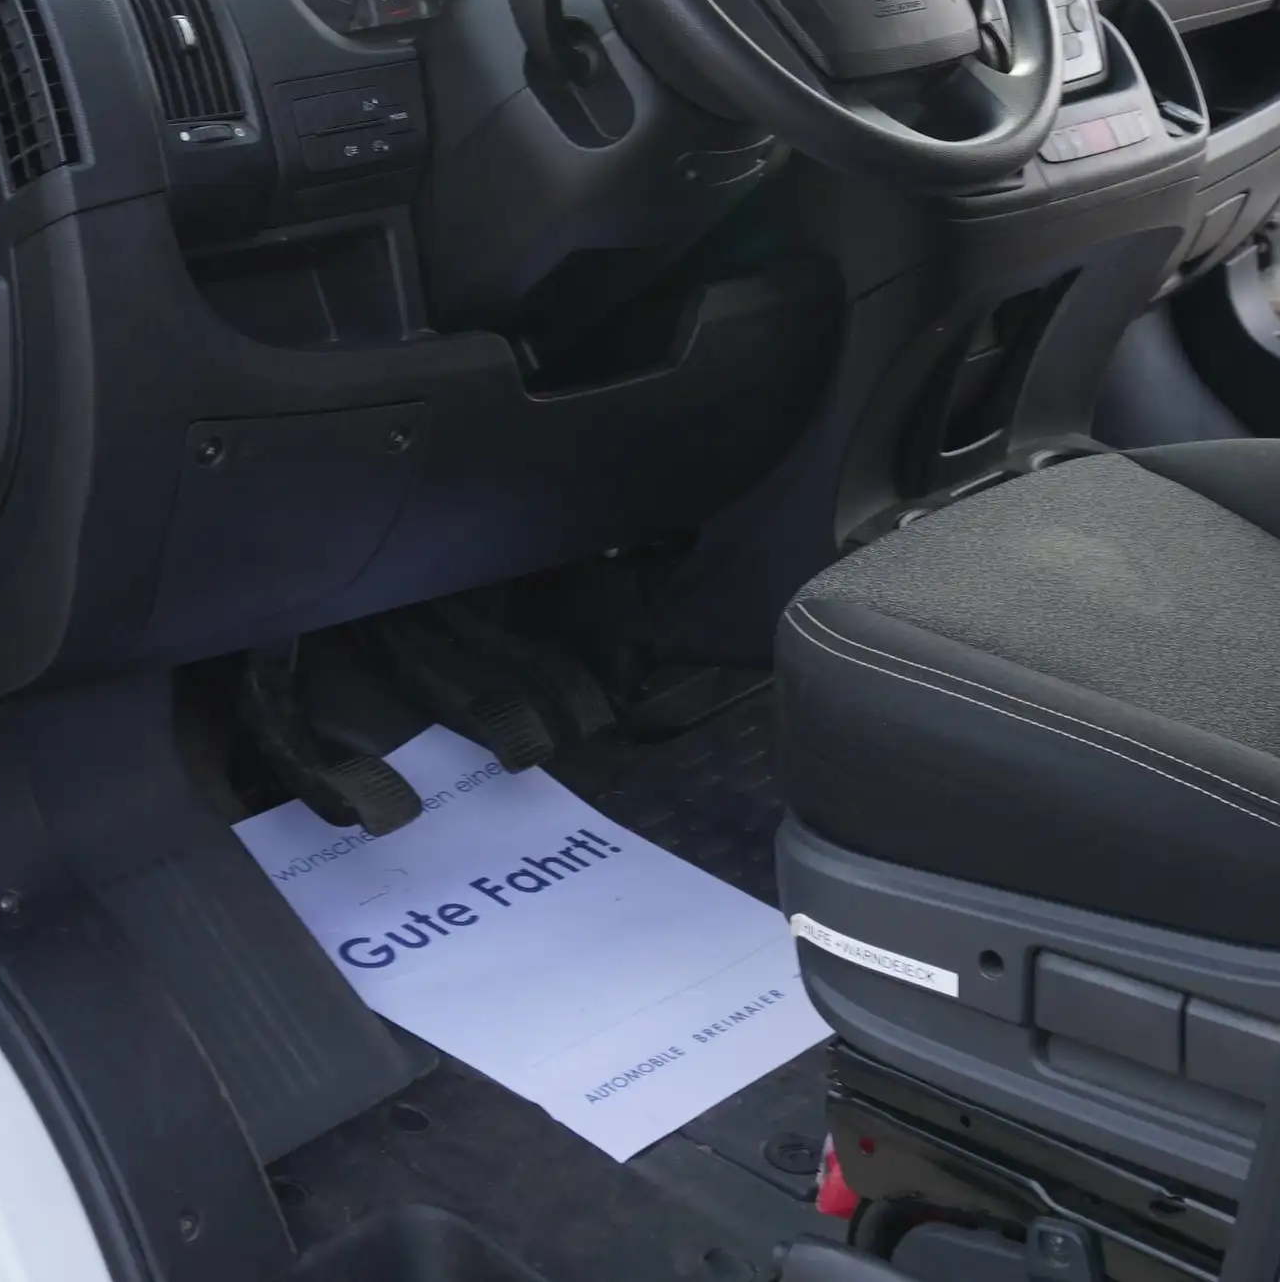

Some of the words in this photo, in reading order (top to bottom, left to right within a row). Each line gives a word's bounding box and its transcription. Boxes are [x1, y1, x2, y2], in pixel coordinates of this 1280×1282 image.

[338, 902, 480, 969] Gute
[468, 828, 623, 908] Fahrt!
[584, 1045, 687, 1105] AUTOMOBILE
[691, 988, 787, 1044] BREIMAIER
